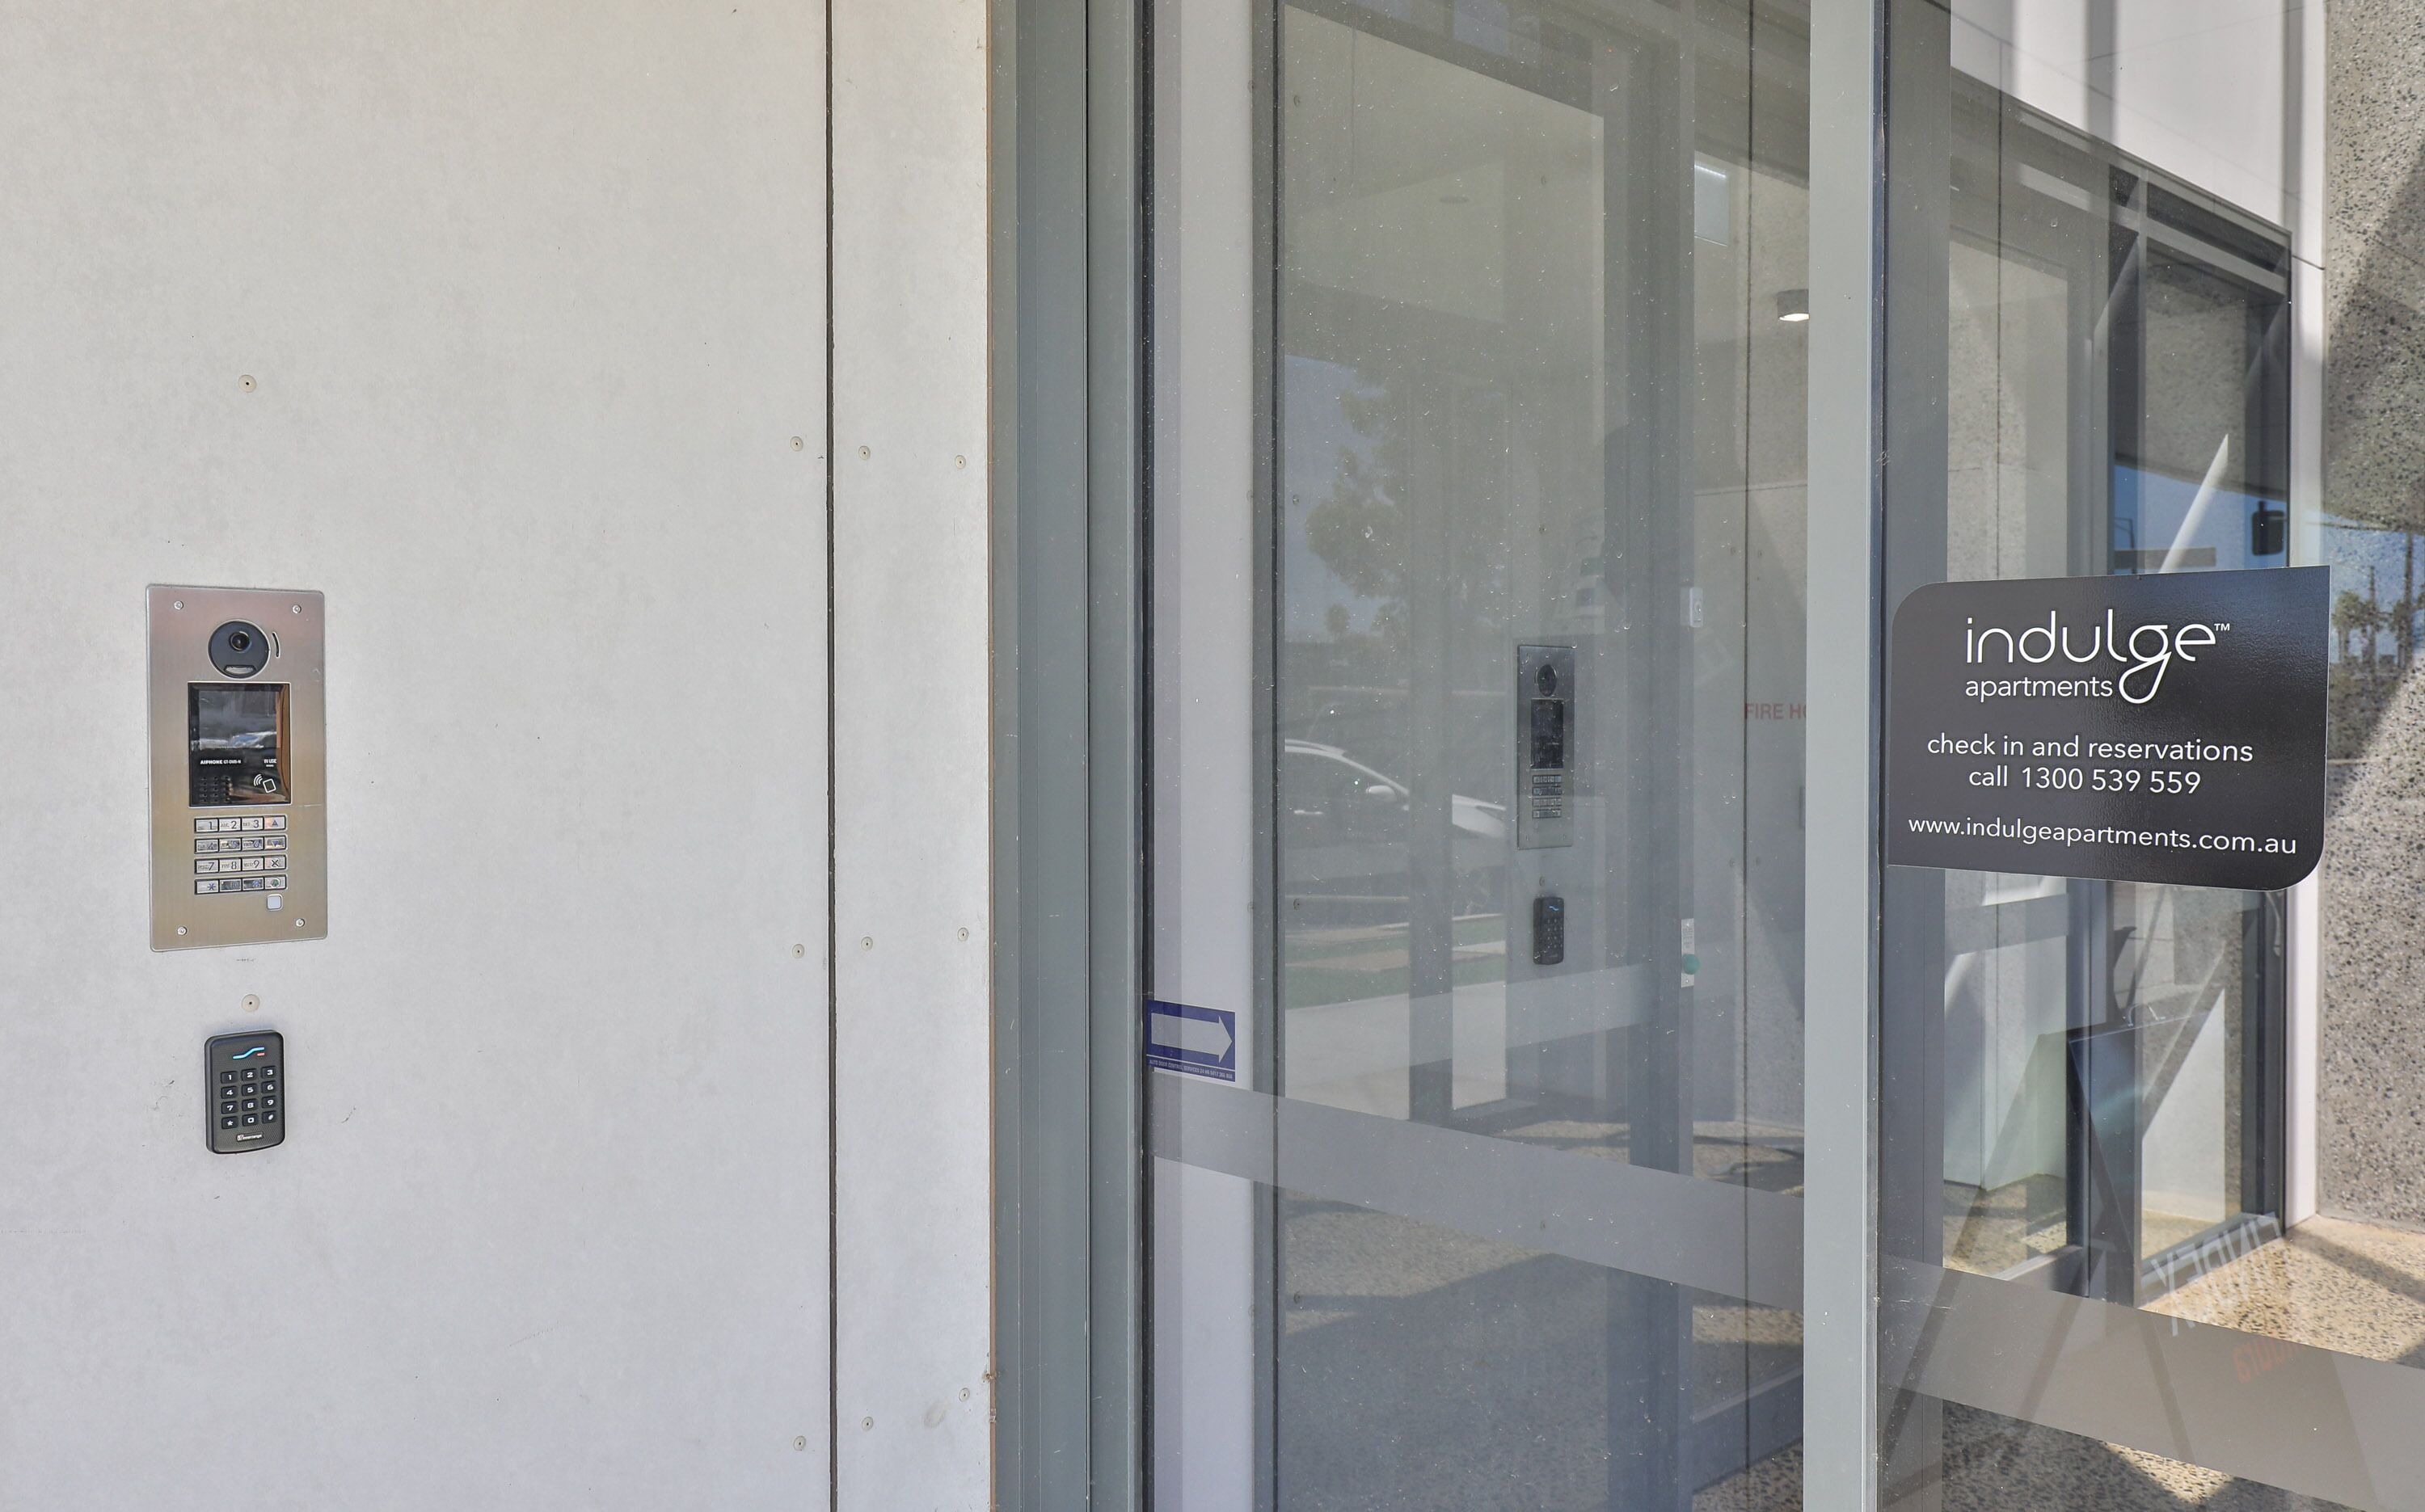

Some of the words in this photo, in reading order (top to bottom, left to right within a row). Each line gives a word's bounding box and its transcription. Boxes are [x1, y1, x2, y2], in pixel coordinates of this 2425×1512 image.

[1965, 609, 2217, 705] indulge
[1965, 676, 2113, 703] apartments
[1745, 702, 1784, 720] FIRE
[1927, 732, 1996, 755] check
[2003, 735, 2024, 756] in
[2031, 735, 2079, 757] and
[2089, 739, 2253, 762] reservations
[1968, 764, 2008, 787] call
[2022, 767, 2083, 790] 1300
[2091, 769, 2141, 792] 539
[2149, 770, 2201, 794] 559
[230, 820, 237, 830] 2
[253, 819, 259, 828] 3
[1908, 817, 2296, 854] www.indulgeapartments.com.au
[208, 861, 215, 871] 7
[230, 861, 237, 870] 8
[253, 860, 260, 869] 9
